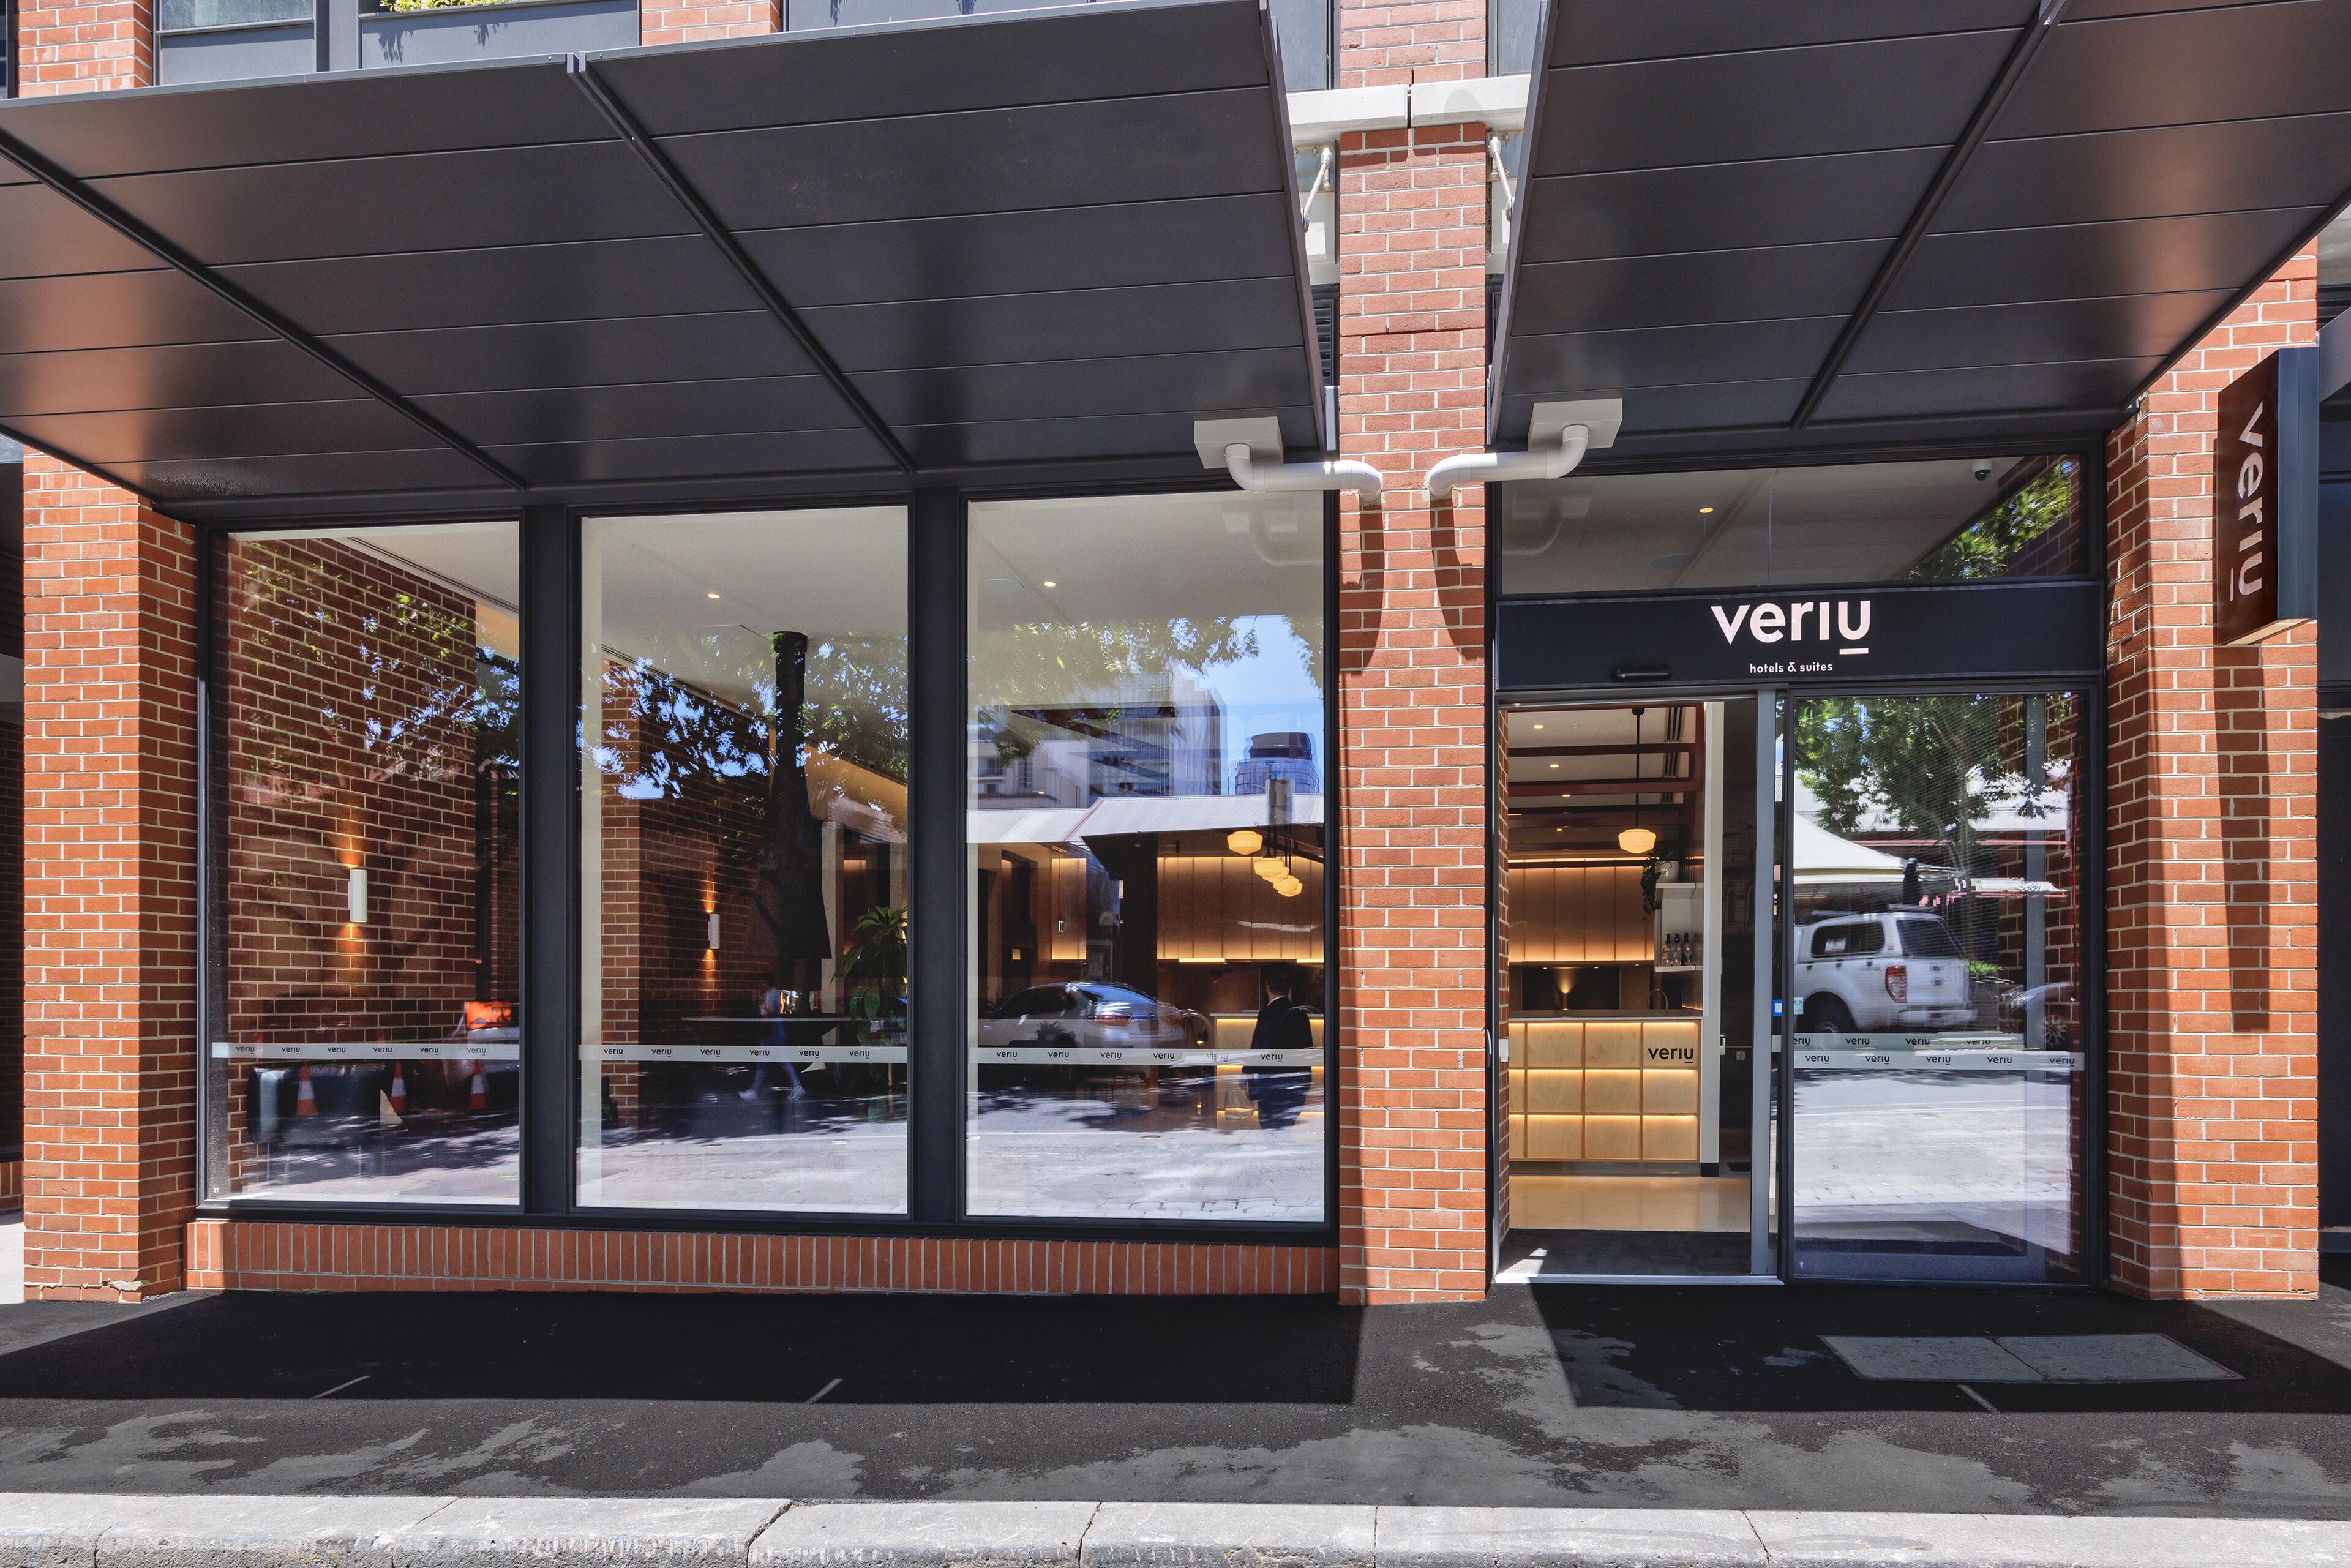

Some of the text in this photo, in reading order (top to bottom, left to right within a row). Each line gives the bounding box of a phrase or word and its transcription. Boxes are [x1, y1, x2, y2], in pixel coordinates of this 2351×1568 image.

[2230, 400, 2263, 601] veriu
[1711, 600, 1871, 655] veriu
[1750, 661, 1833, 673] hotels & suites
[1793, 1038, 1810, 1047] eriu
[1845, 1038, 1870, 1047] veriu
[236, 1046, 255, 1054] veriu
[281, 1046, 300, 1055] veriu
[327, 1046, 346, 1055] veriu
[372, 1046, 392, 1055] veriu
[419, 1046, 439, 1055] veriu
[603, 1048, 870, 1059] veriu veriu veriu veriu veriu veriu
[996, 1051, 1018, 1060] veriu
[1048, 1051, 1070, 1060] veriu
[1100, 1052, 1122, 1060] veriu
[1153, 1052, 1175, 1061] veriu
[1260, 1052, 1283, 1062] veriu
[1648, 1048, 1694, 1064] veriu
[1805, 1055, 2075, 1067] veriu veriu veriu veriu veriu
